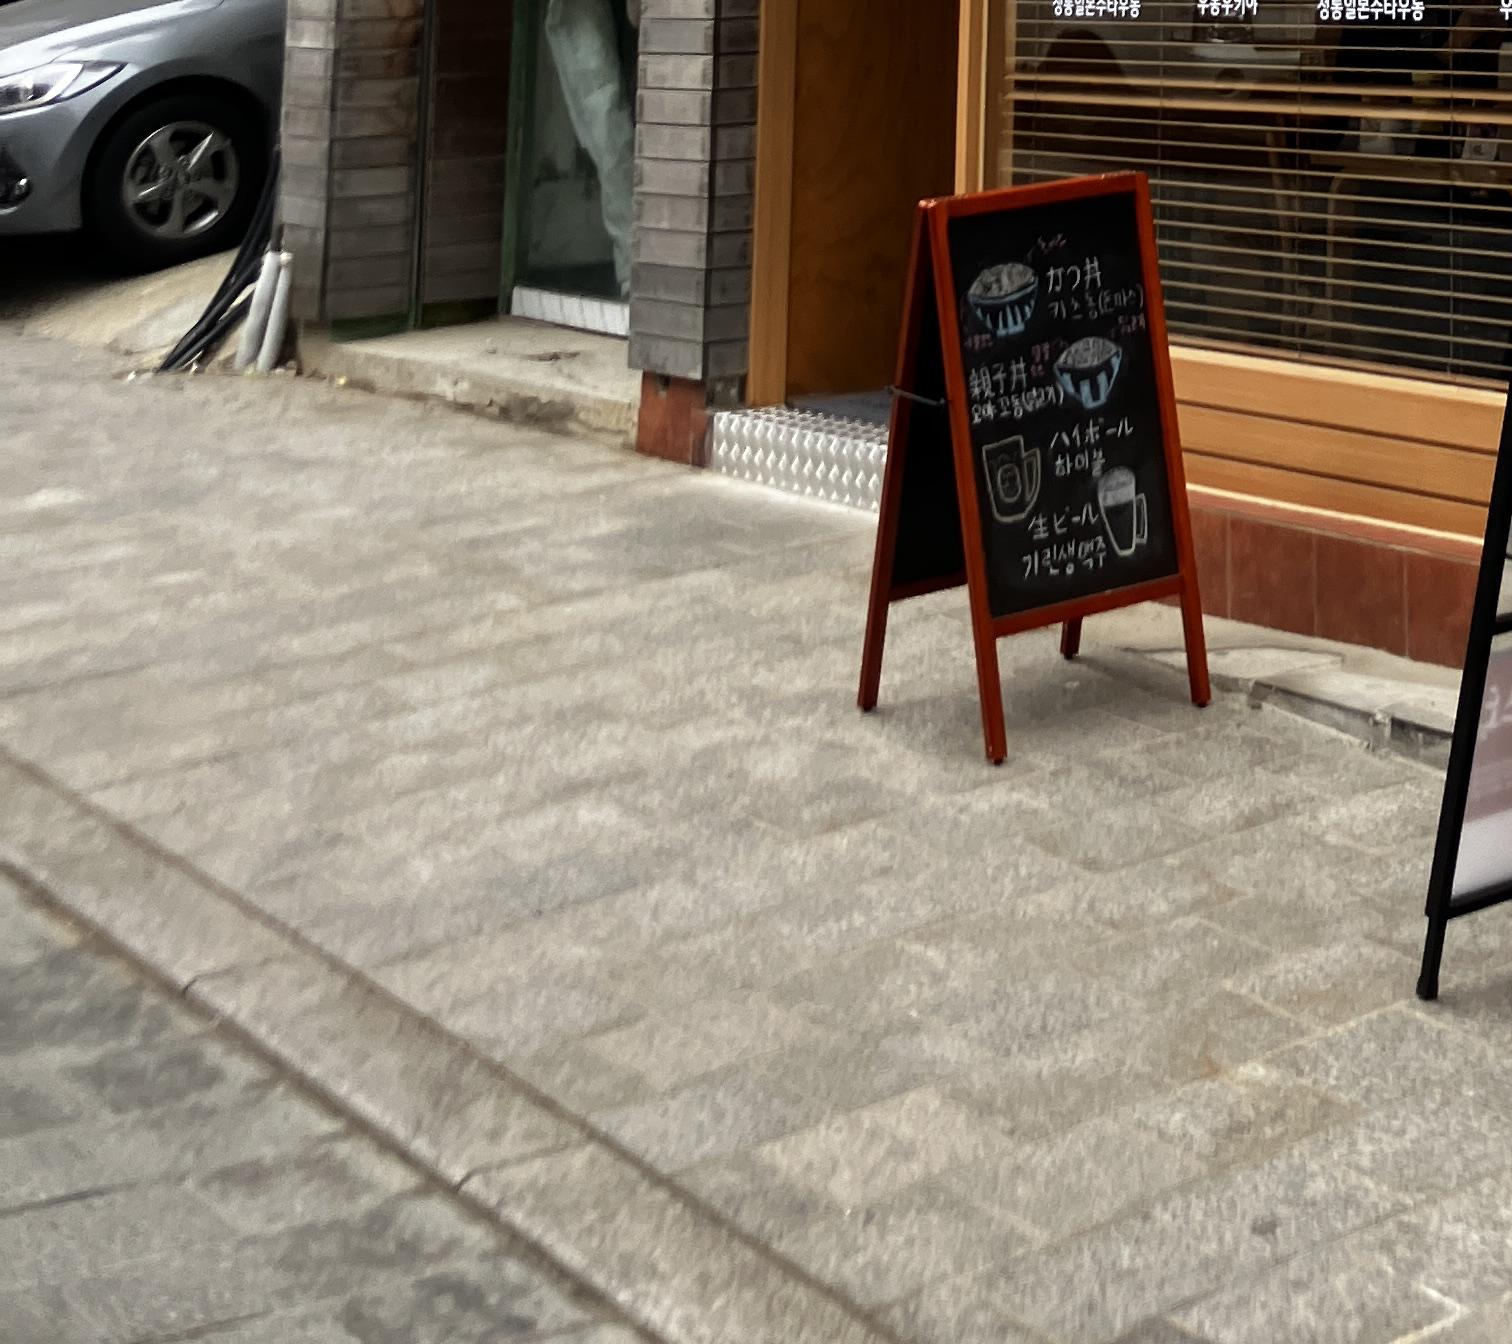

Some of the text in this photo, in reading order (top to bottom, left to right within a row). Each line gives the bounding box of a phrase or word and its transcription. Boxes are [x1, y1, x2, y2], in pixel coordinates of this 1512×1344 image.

[1050, 417, 1134, 449] ハイボール
[1055, 448, 1106, 478] 하이볼
[1028, 503, 1100, 541] 生ビール
